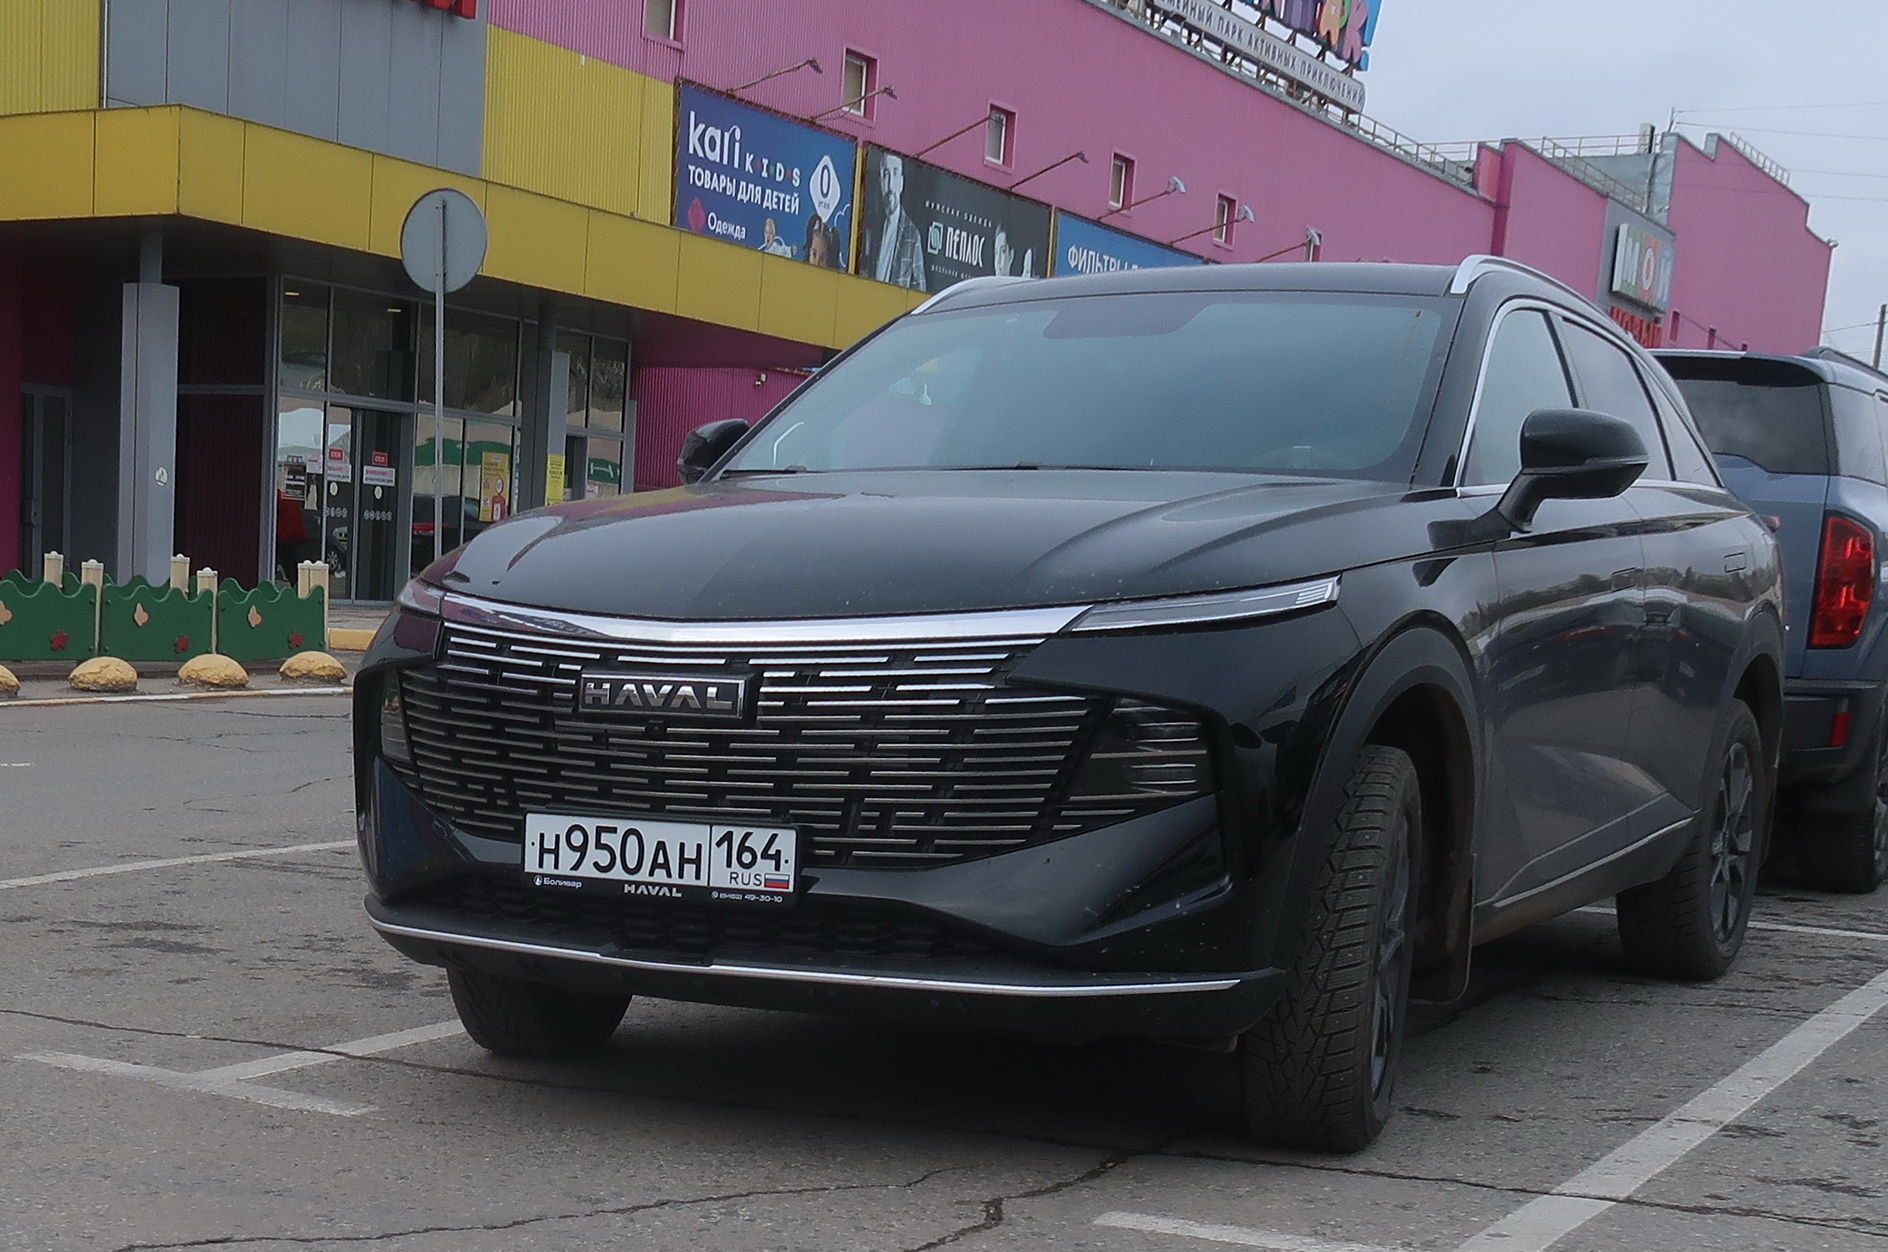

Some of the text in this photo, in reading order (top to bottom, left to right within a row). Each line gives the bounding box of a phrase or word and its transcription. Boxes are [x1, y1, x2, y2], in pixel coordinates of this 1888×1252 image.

[1216, 16, 1243, 44] ПАРК
[1247, 33, 1297, 71] АКТИВНЫХ
[1301, 60, 1364, 105] ПРИКЛЮЧЕНИЙ
[688, 110, 742, 169] kari
[688, 164, 800, 216] ТОВАРЫ ДЛЯ ДЕТЕЙ
[819, 164, 831, 199] 0
[707, 212, 747, 240] Одежда
[585, 682, 733, 710] HAVAL
[538, 823, 782, 881] Н950АН 164
[543, 877, 583, 889] Боливар
[624, 883, 683, 898] HAVAL
[729, 871, 763, 887] RUS
